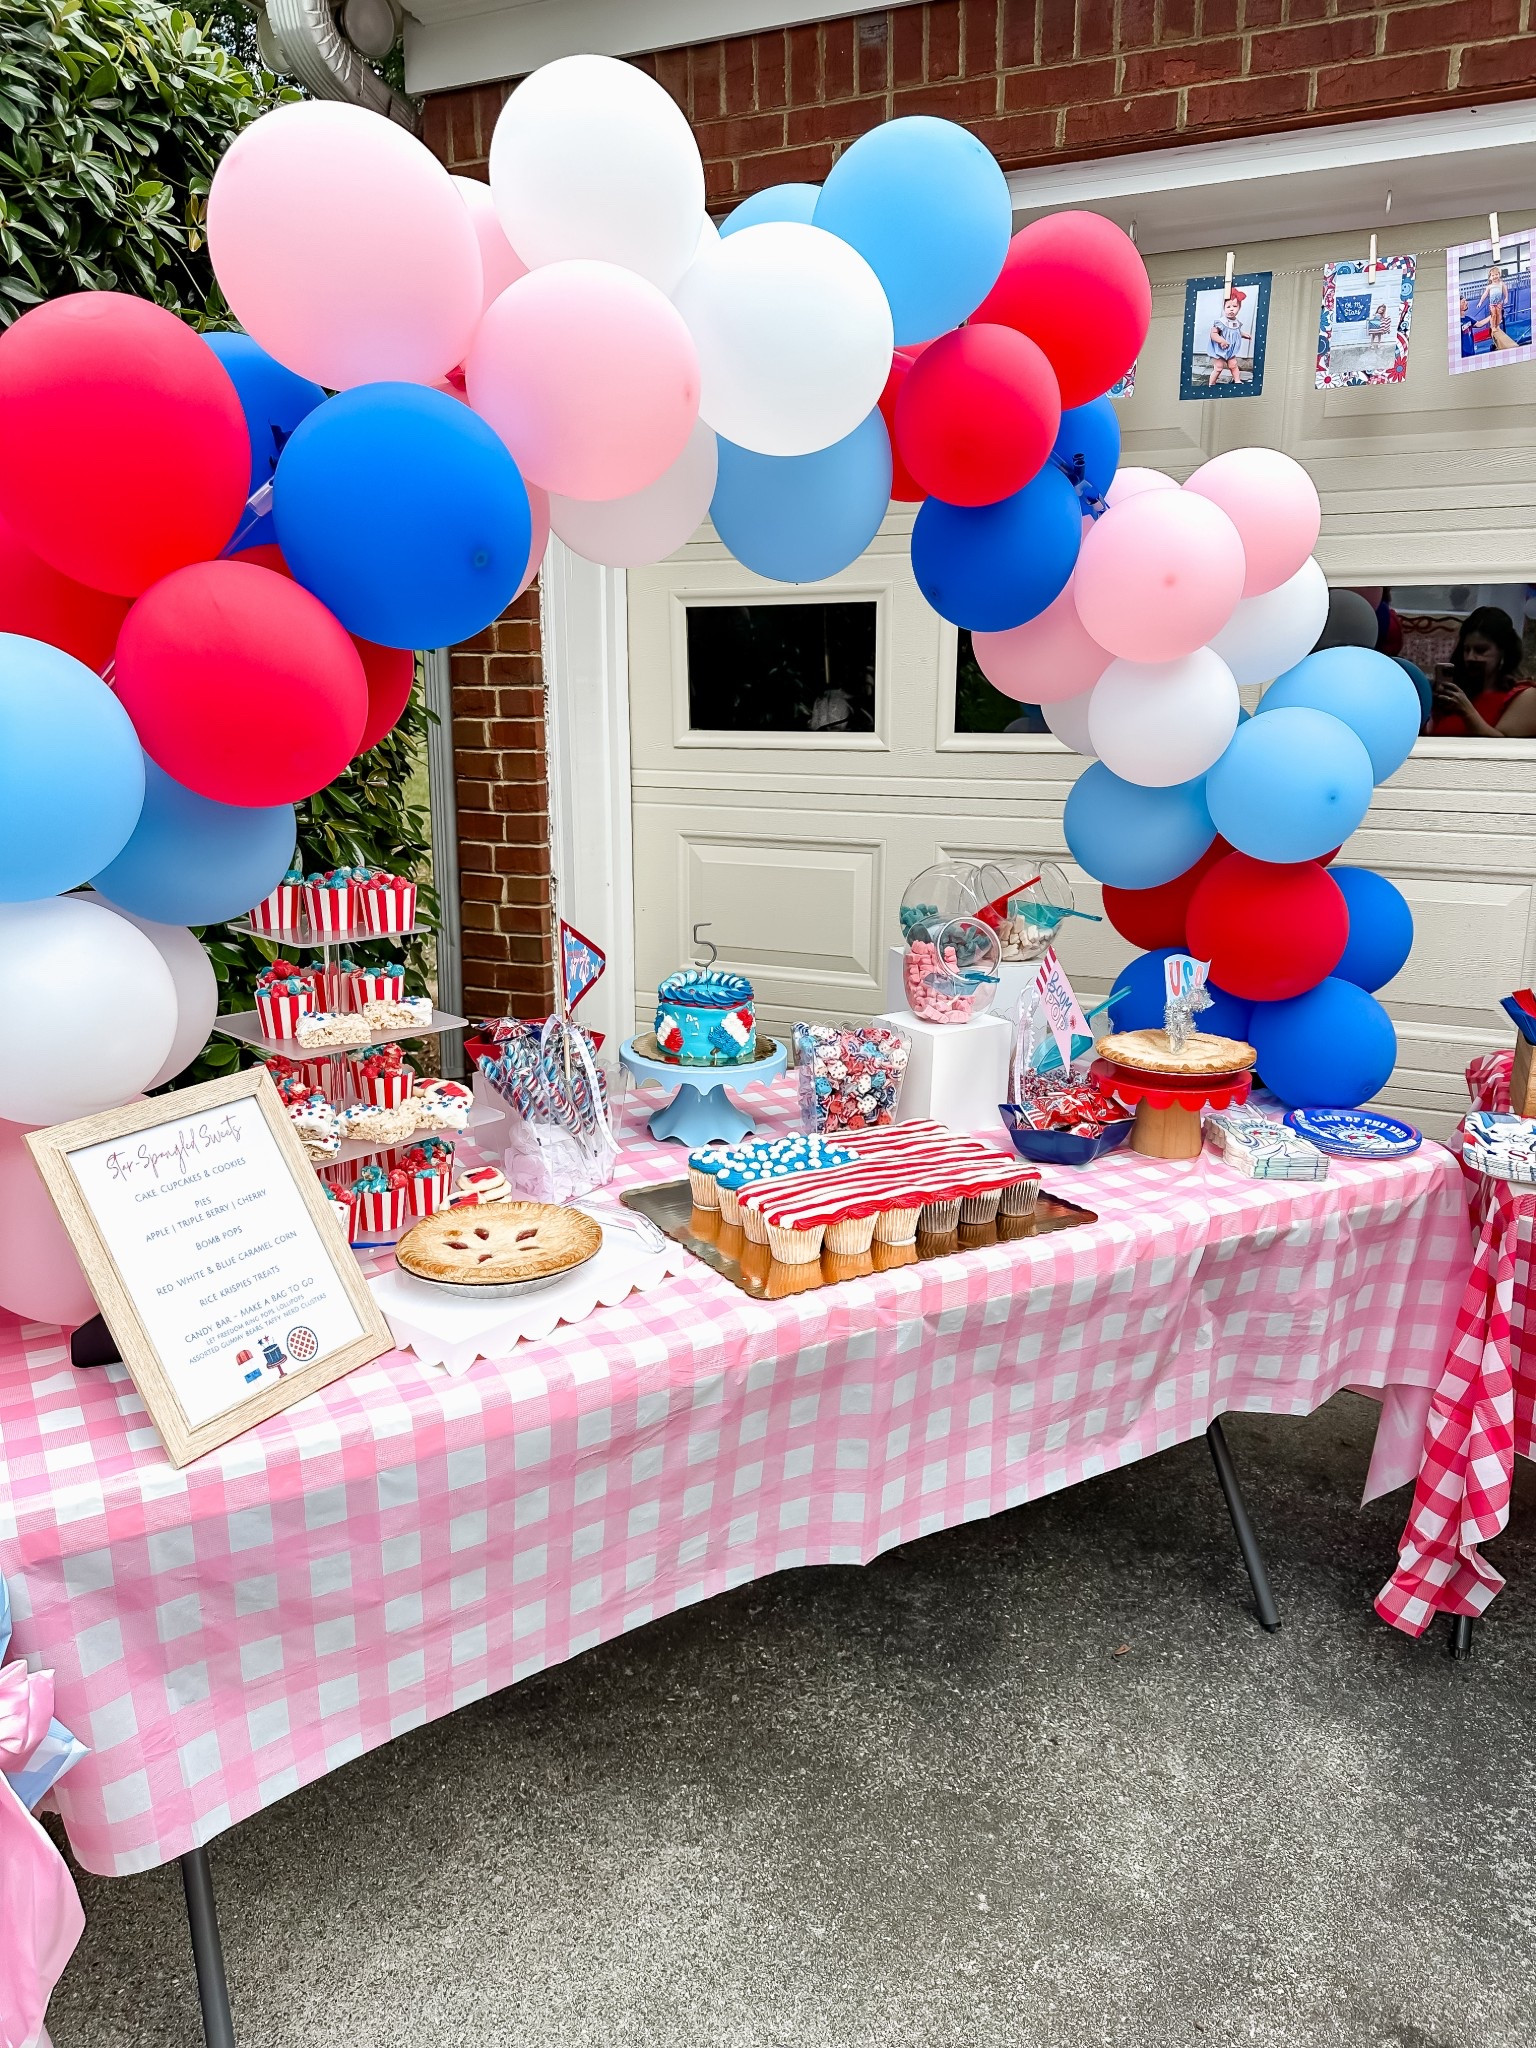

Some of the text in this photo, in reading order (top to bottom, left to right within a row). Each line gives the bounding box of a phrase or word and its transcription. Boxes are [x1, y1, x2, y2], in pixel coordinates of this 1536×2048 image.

[693, 923, 717, 967] 5
[1047, 971, 1072, 1018] BOOM
[1169, 960, 1203, 997] USA
[1045, 992, 1067, 1031] POP
[1311, 1115, 1341, 1123] LAND
[1364, 1118, 1388, 1129] THE
[107, 1115, 242, 1181] Star-Spangled Sweets
[135, 1157, 246, 1203] CAKE CUPCAKES & COOKIES
[194, 1196, 212, 1208] PIES
[146, 1226, 170, 1242] APPLE
[177, 1213, 204, 1229] TRIPLE
[206, 1203, 229, 1218] BERRY
[237, 1188, 266, 1206] CHERRY
[195, 1225, 243, 1250] BOMB POPS
[156, 1230, 297, 1296] RED WHITE & BLUE CARAMEL CORN
[199, 1265, 280, 1307] RICE KRISPIES TREATS
[184, 1325, 213, 1343] CANDY
[215, 1316, 232, 1329] BAR
[240, 1301, 262, 1317] MAKE
[264, 1298, 270, 1306] A
[271, 1290, 287, 1302] BAG
[288, 1283, 300, 1295] TO
[301, 1277, 314, 1288] GO
[189, 1345, 220, 1365] ASSORTED
[221, 1334, 245, 1349] GUMMY
[283, 1306, 300, 1317] NERD
[300, 1292, 327, 1309] CLUSTERS
[206, 1337, 216, 1345] LET
[217, 1323, 244, 1339] FREEDOM
[244, 1316, 260, 1327] RING
[276, 1294, 304, 1311] LOLLIPOPS
